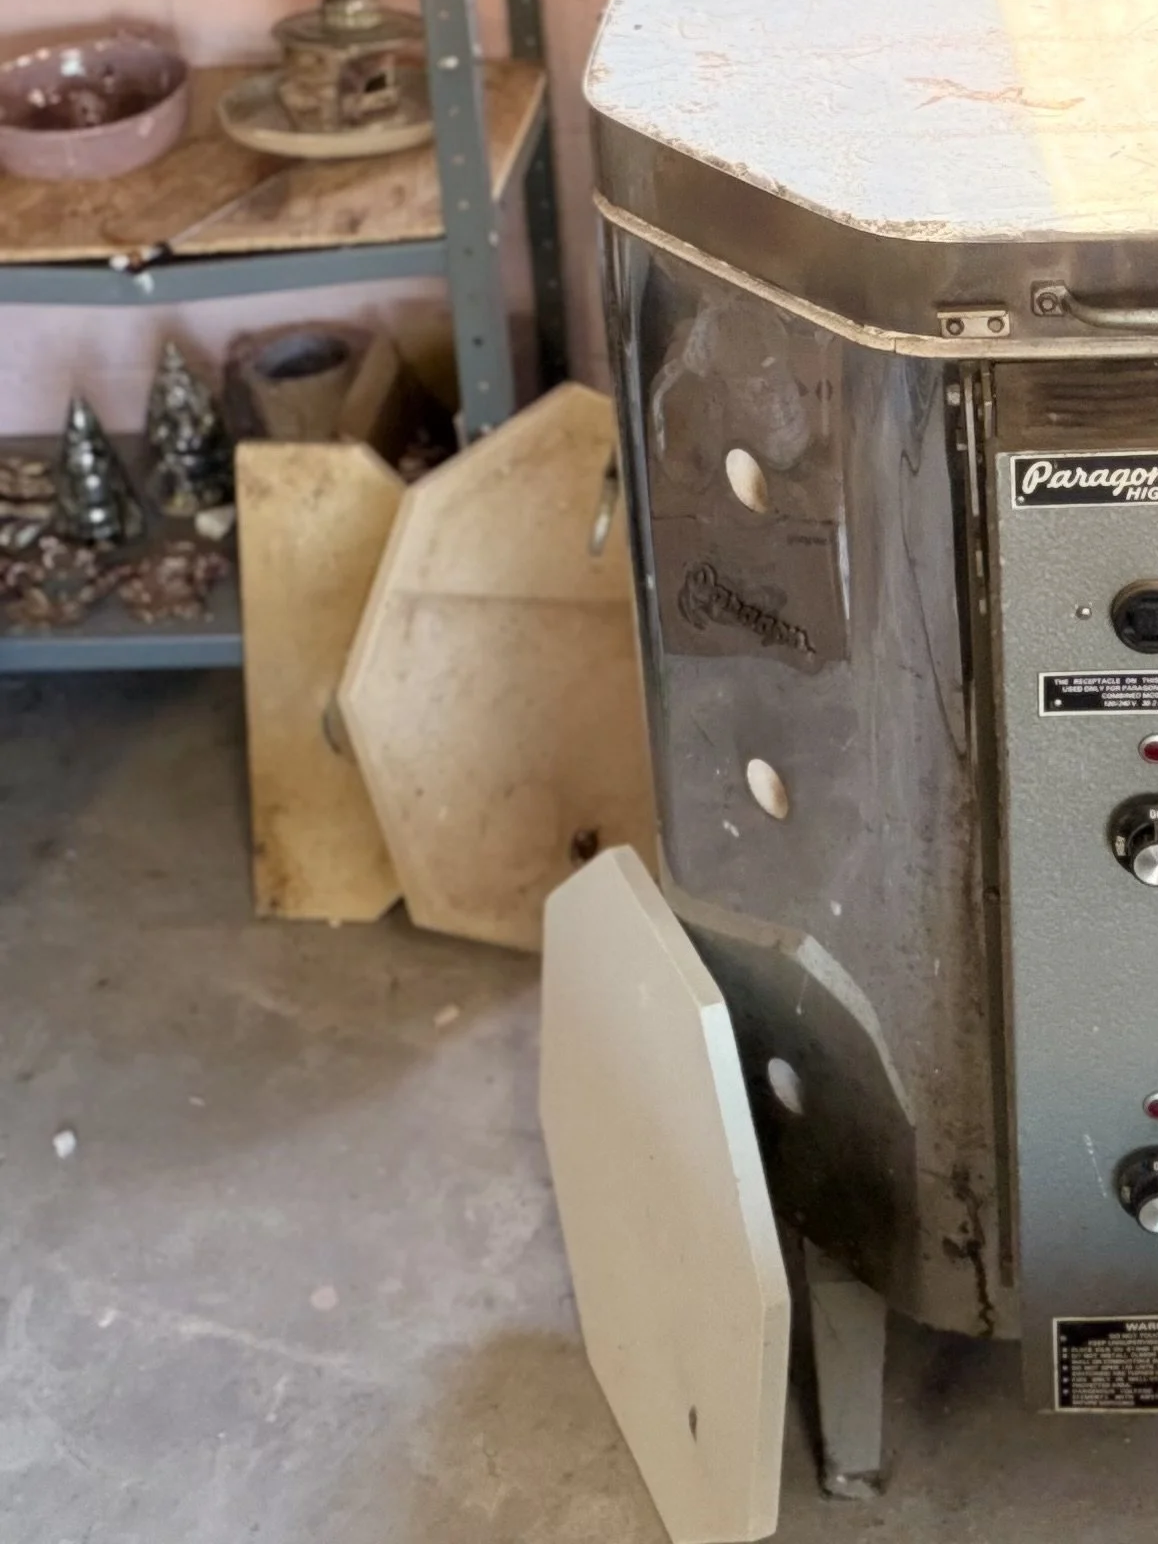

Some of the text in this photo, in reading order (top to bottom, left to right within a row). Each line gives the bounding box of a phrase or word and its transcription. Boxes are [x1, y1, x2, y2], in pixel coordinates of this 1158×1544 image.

[1054, 678, 1069, 686] THE
[1073, 677, 1121, 685] RECEPTACLE
[1062, 685, 1083, 693] USED
[1101, 692, 1142, 700] COMBINED
